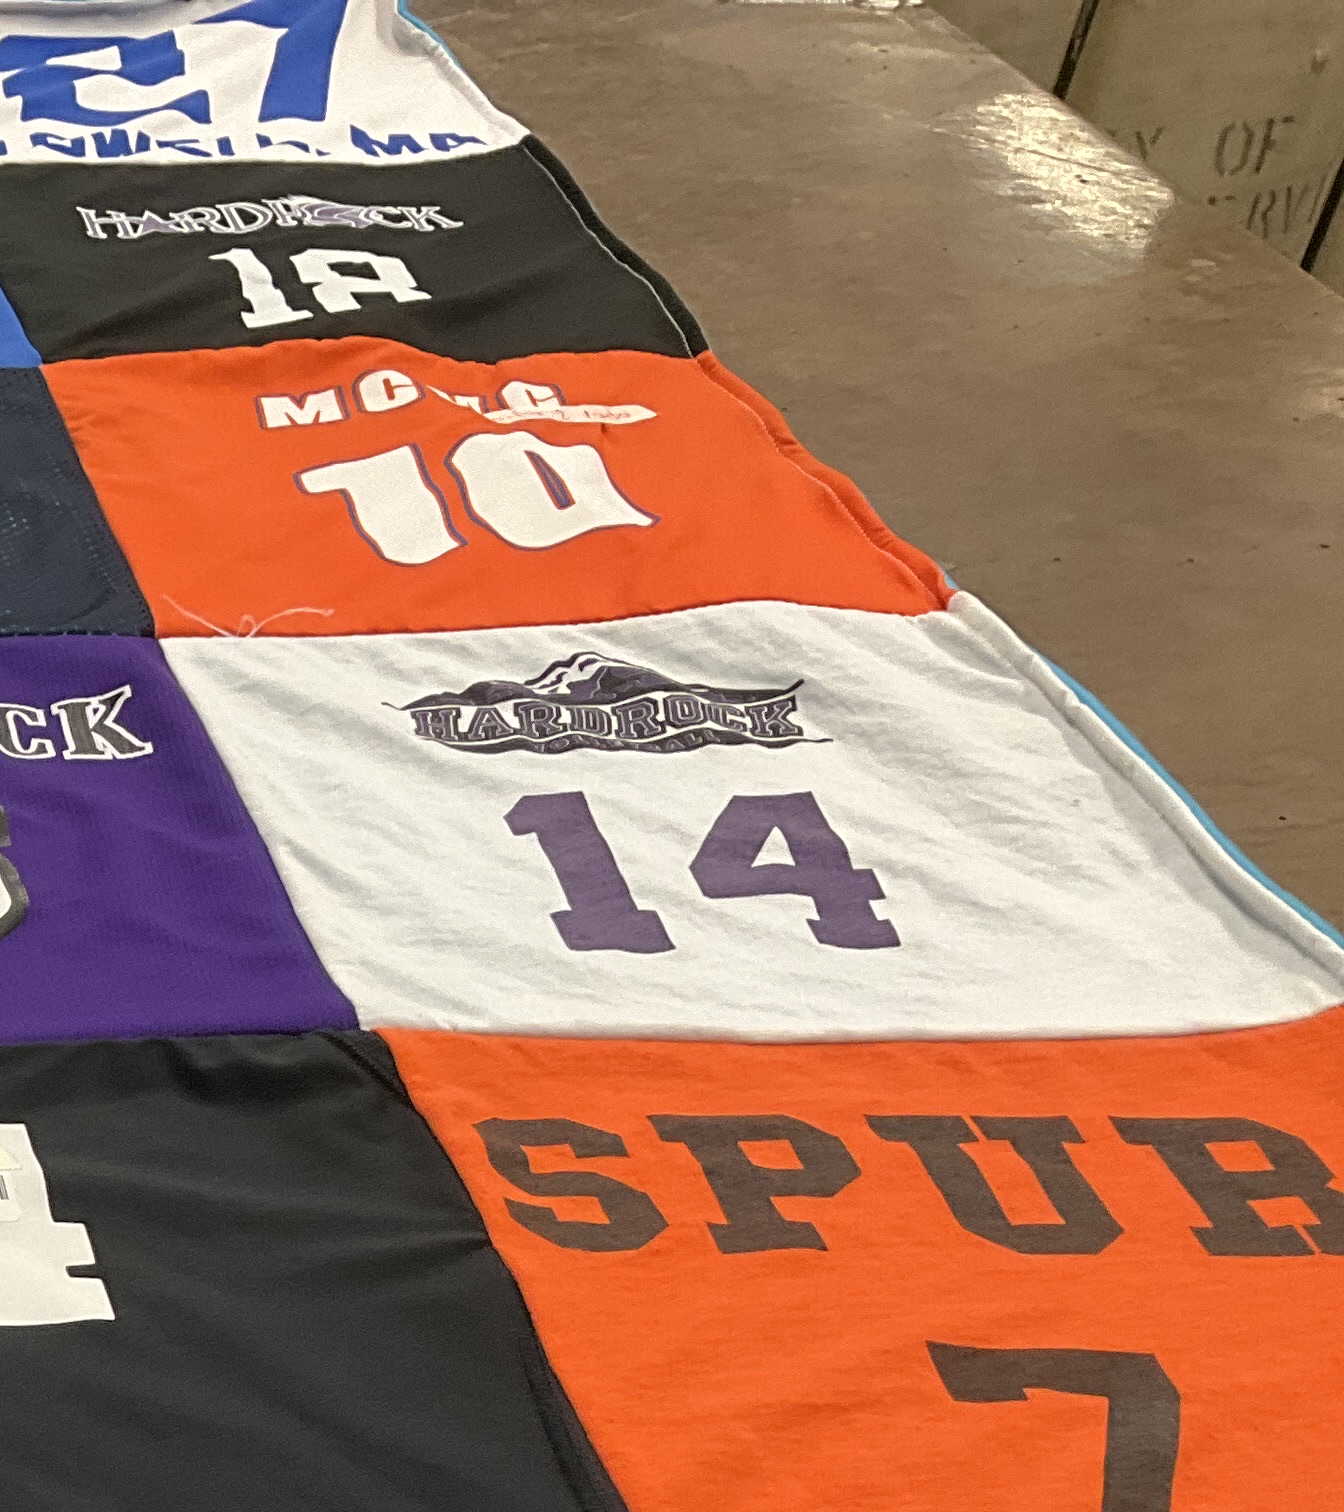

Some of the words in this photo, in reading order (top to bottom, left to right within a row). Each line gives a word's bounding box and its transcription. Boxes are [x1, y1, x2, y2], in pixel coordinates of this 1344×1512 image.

[1216, 116, 1295, 175] OF
[293, 430, 661, 567] 10
[412, 694, 805, 742] HARDROCK
[502, 790, 902, 954] 14
